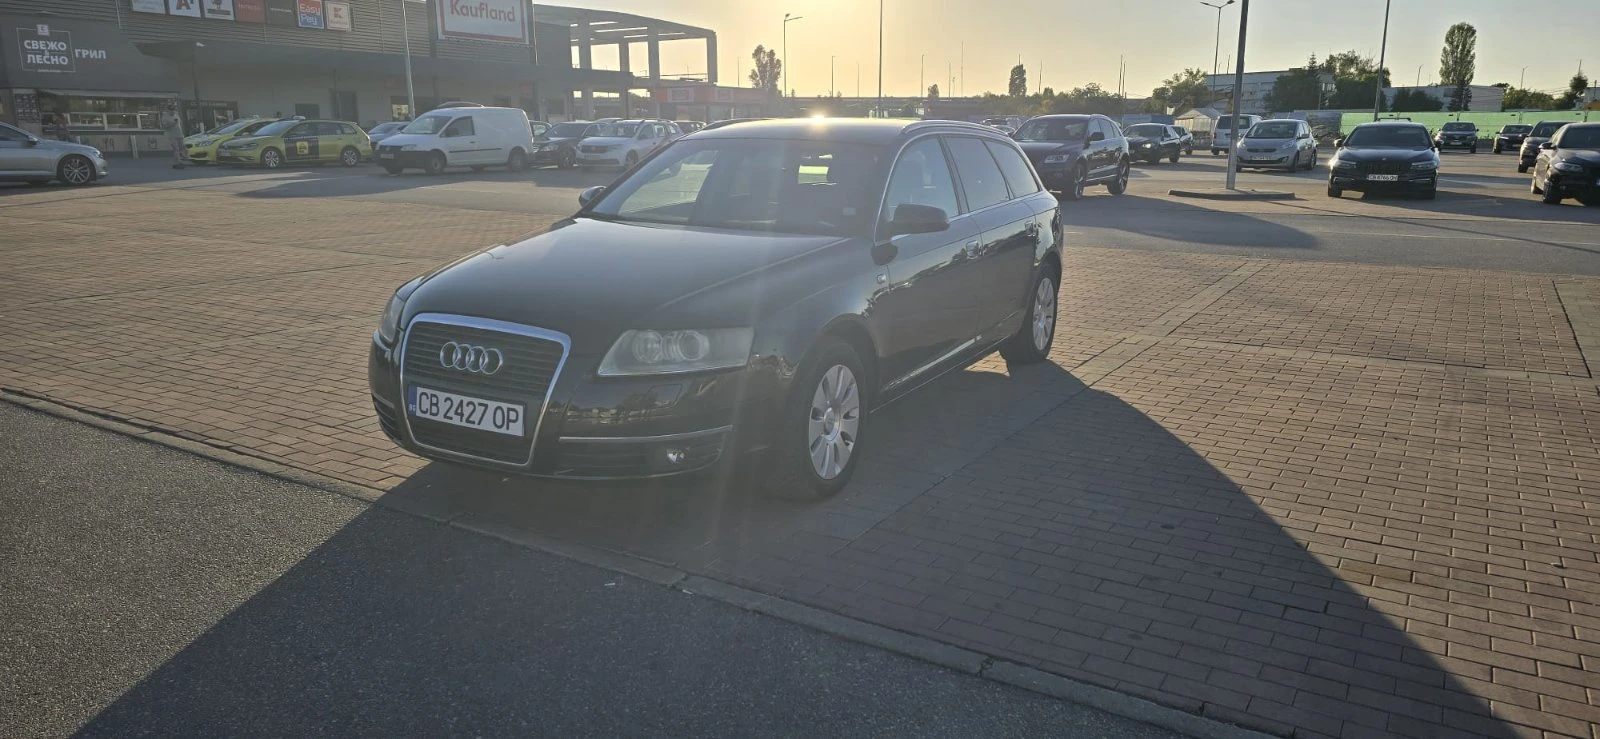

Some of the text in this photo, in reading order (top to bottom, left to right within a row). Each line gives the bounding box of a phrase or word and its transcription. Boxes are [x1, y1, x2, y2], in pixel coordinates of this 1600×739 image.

[299, 3, 321, 16] Easy
[450, 0, 516, 22] Kaufland
[300, 14, 318, 25] Pay
[24, 40, 67, 51] СВЕЖО
[75, 48, 107, 59] ГРИЛ
[27, 54, 69, 65] ЛЕСНО
[419, 392, 520, 431] CB 2427 OP
